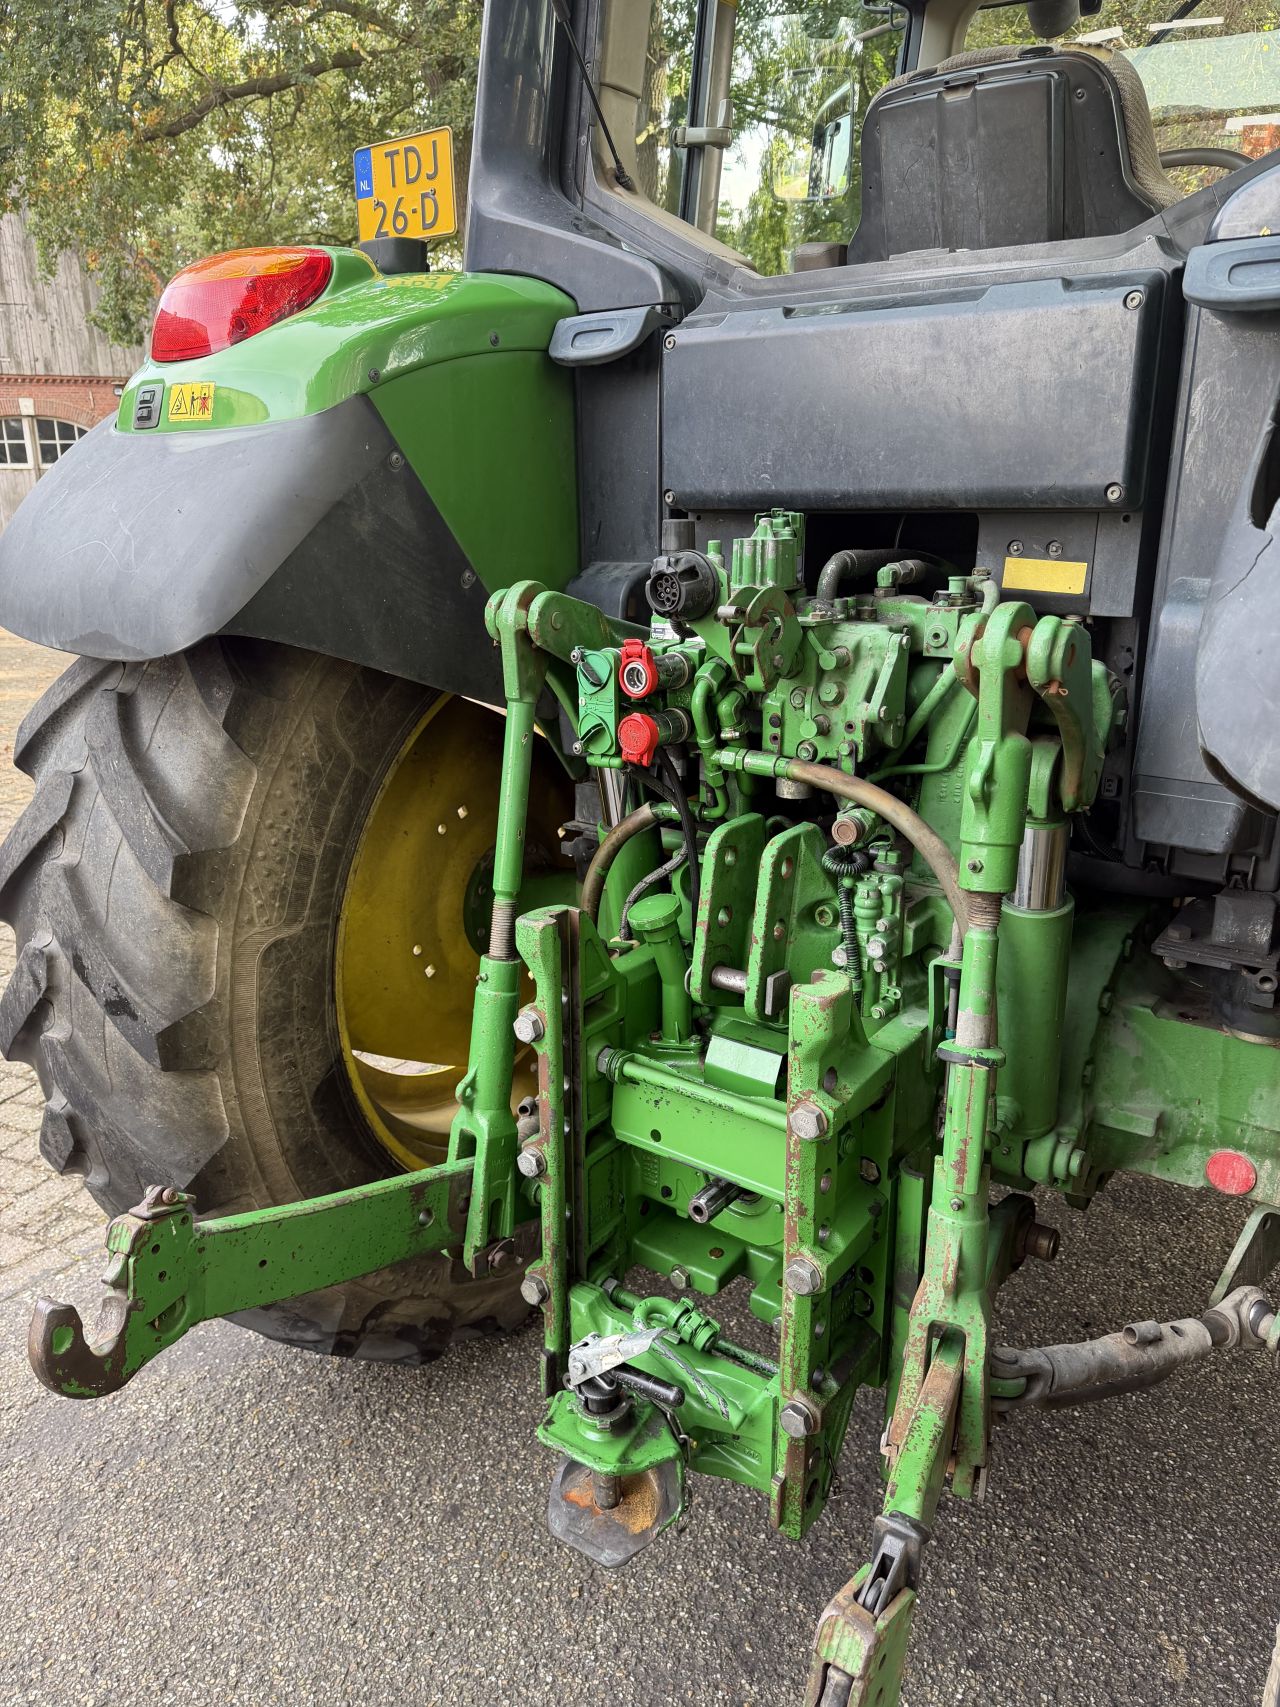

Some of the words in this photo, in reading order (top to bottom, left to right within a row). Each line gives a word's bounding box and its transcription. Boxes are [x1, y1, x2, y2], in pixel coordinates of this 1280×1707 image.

[360, 180, 371, 192] NL
[384, 140, 439, 188] TDJ
[373, 191, 439, 239] 26-D
